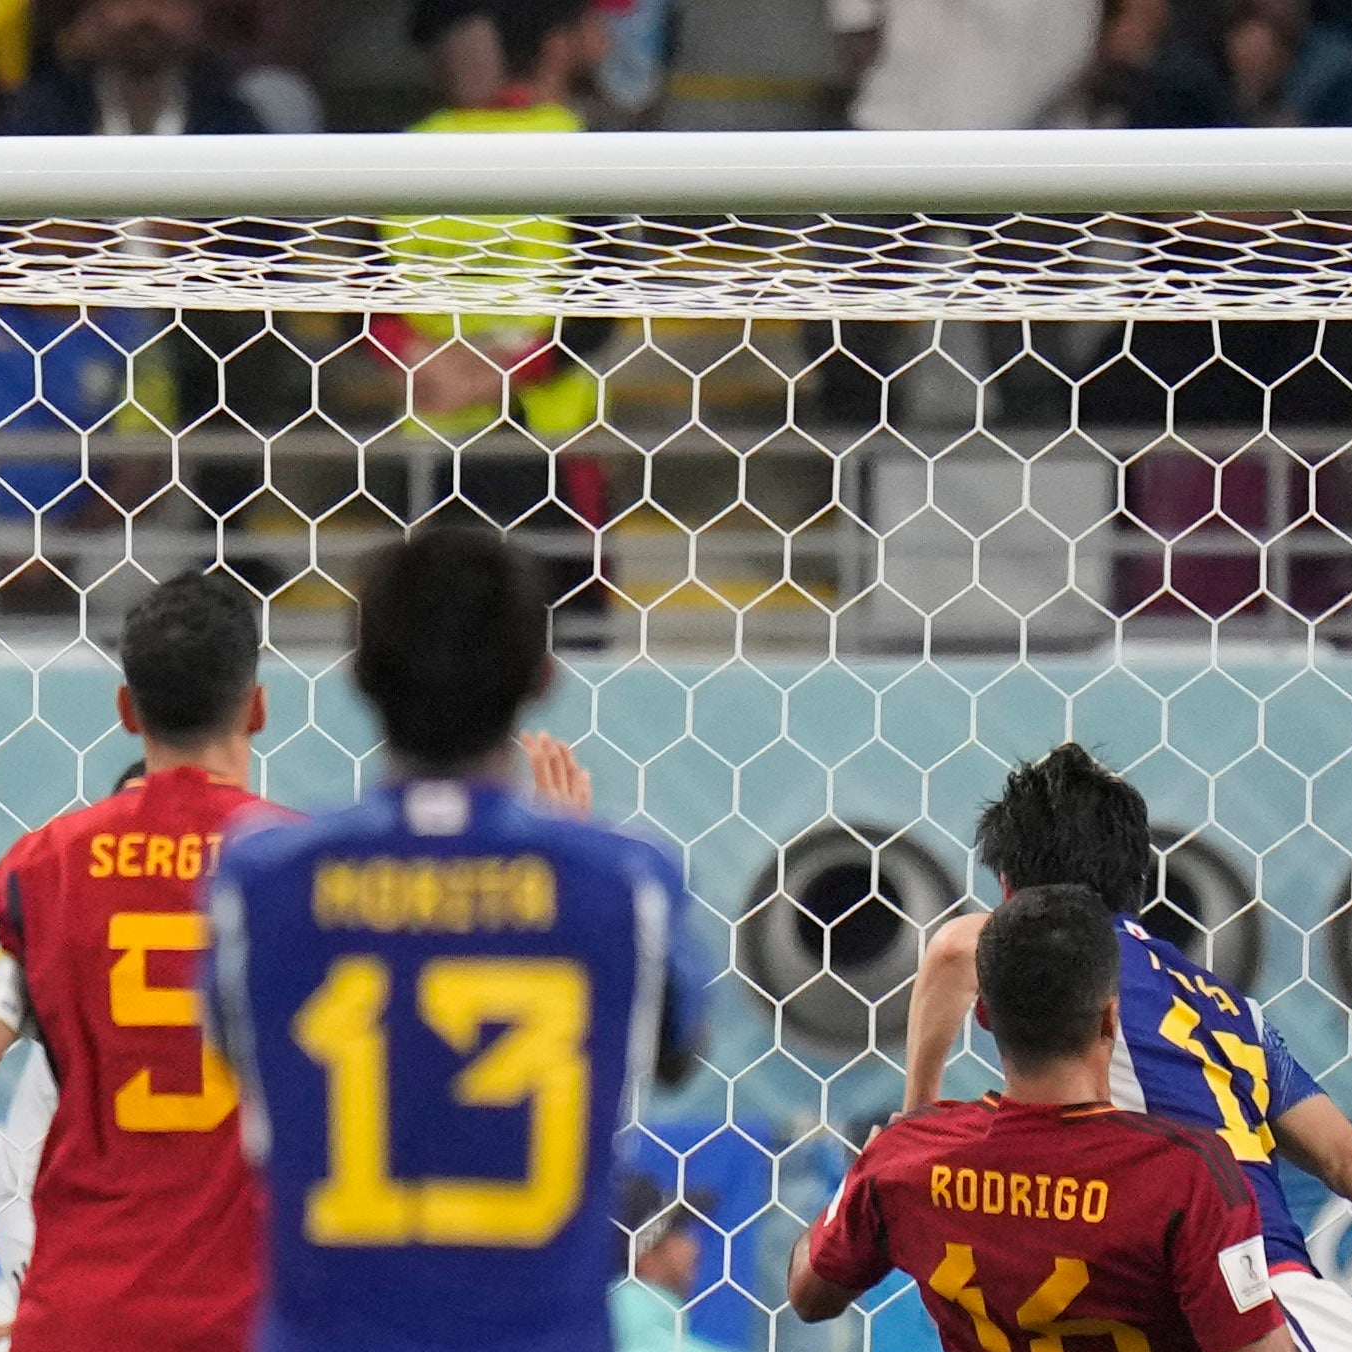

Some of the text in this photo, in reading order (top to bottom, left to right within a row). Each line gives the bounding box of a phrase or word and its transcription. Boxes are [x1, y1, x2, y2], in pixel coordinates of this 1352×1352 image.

[88, 832, 225, 880] SERGI
[108, 913, 241, 1132] 5
[292, 954, 590, 1247] 13
[930, 1164, 1109, 1224] RODRIGO
